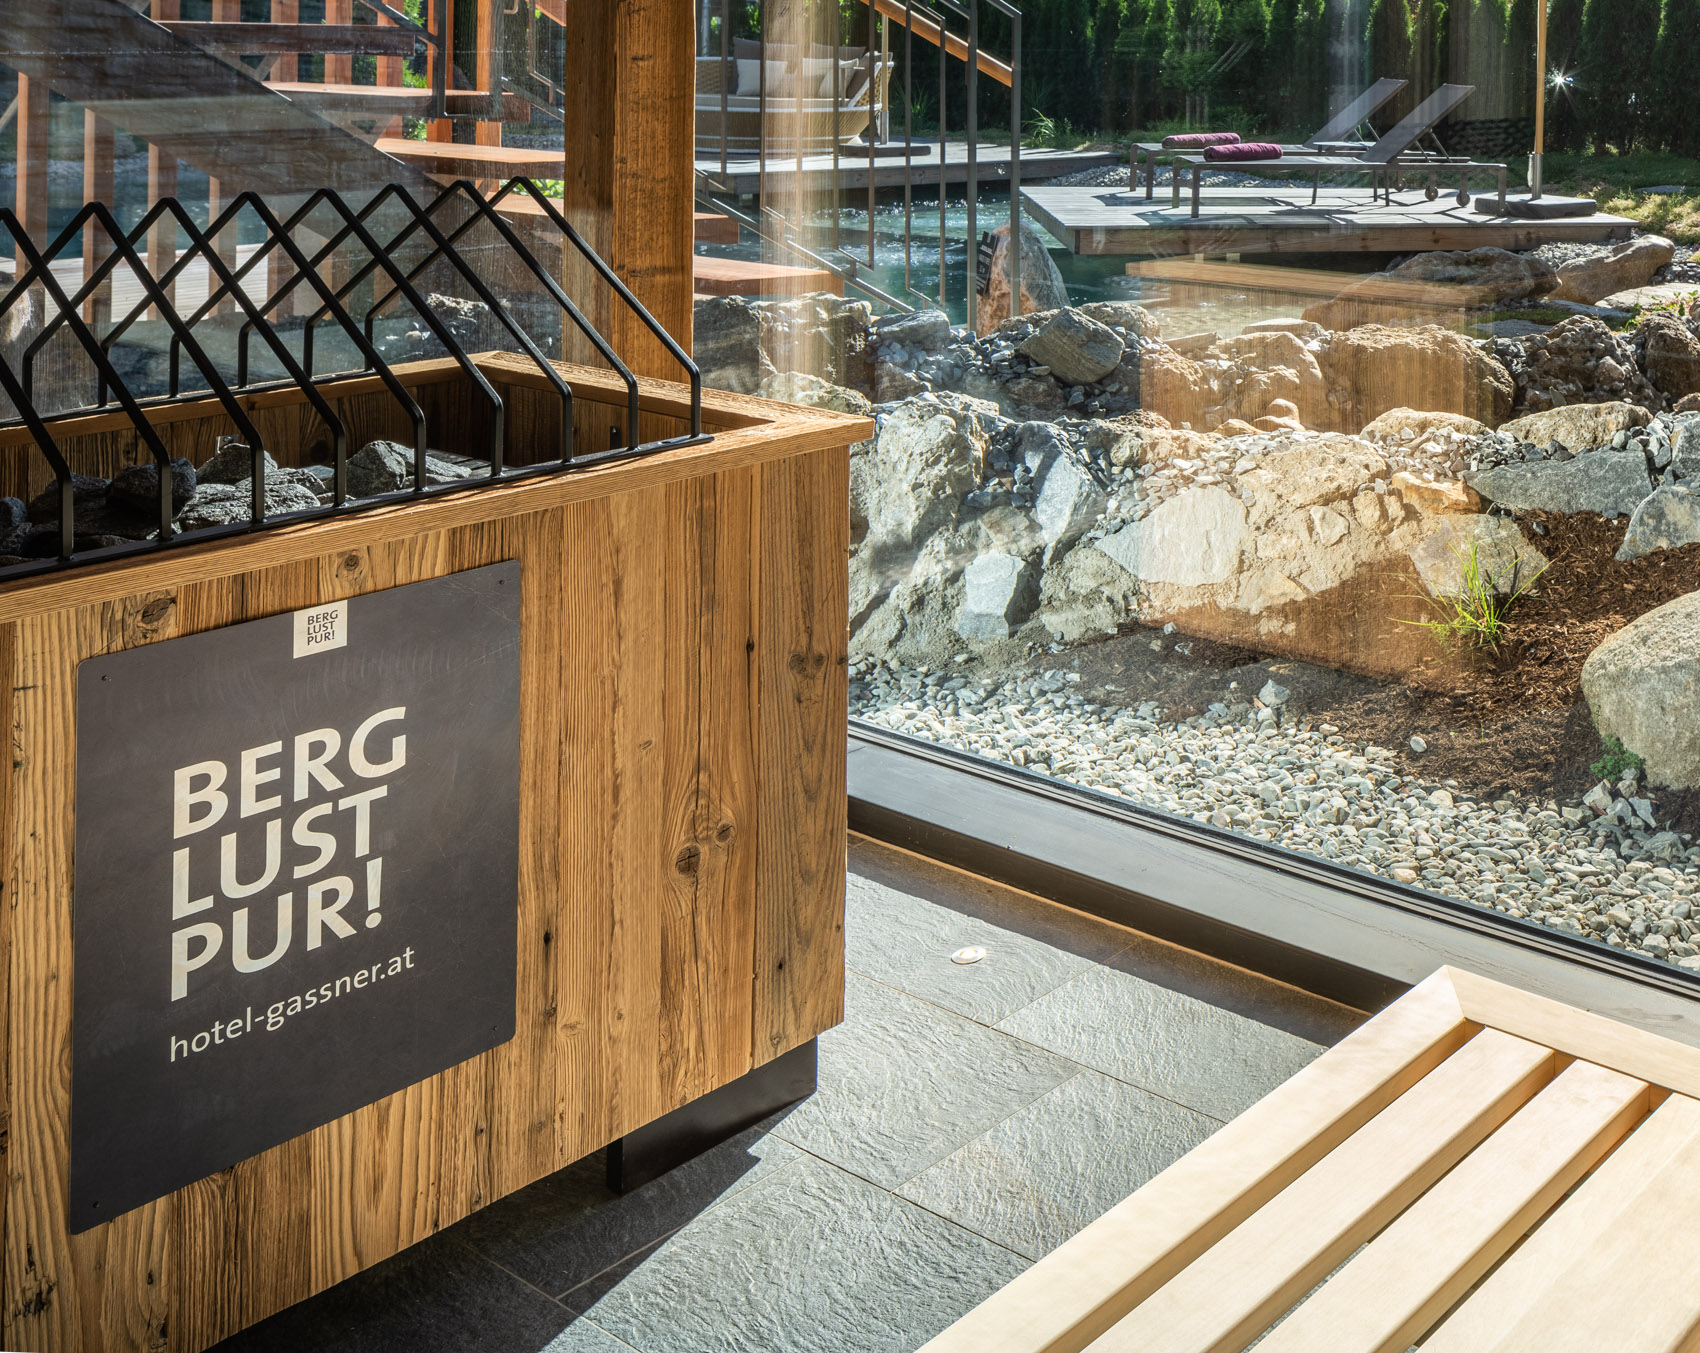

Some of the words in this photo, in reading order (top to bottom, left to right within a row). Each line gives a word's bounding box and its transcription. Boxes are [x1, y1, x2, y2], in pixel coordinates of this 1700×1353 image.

[307, 609, 338, 626] BERG
[307, 620, 336, 636] LUST
[307, 630, 335, 646] PUR!
[172, 705, 407, 840] BERG
[171, 785, 389, 922] LUST
[170, 856, 383, 1002] PUR!
[169, 945, 416, 1063] hotel-gassner.at
